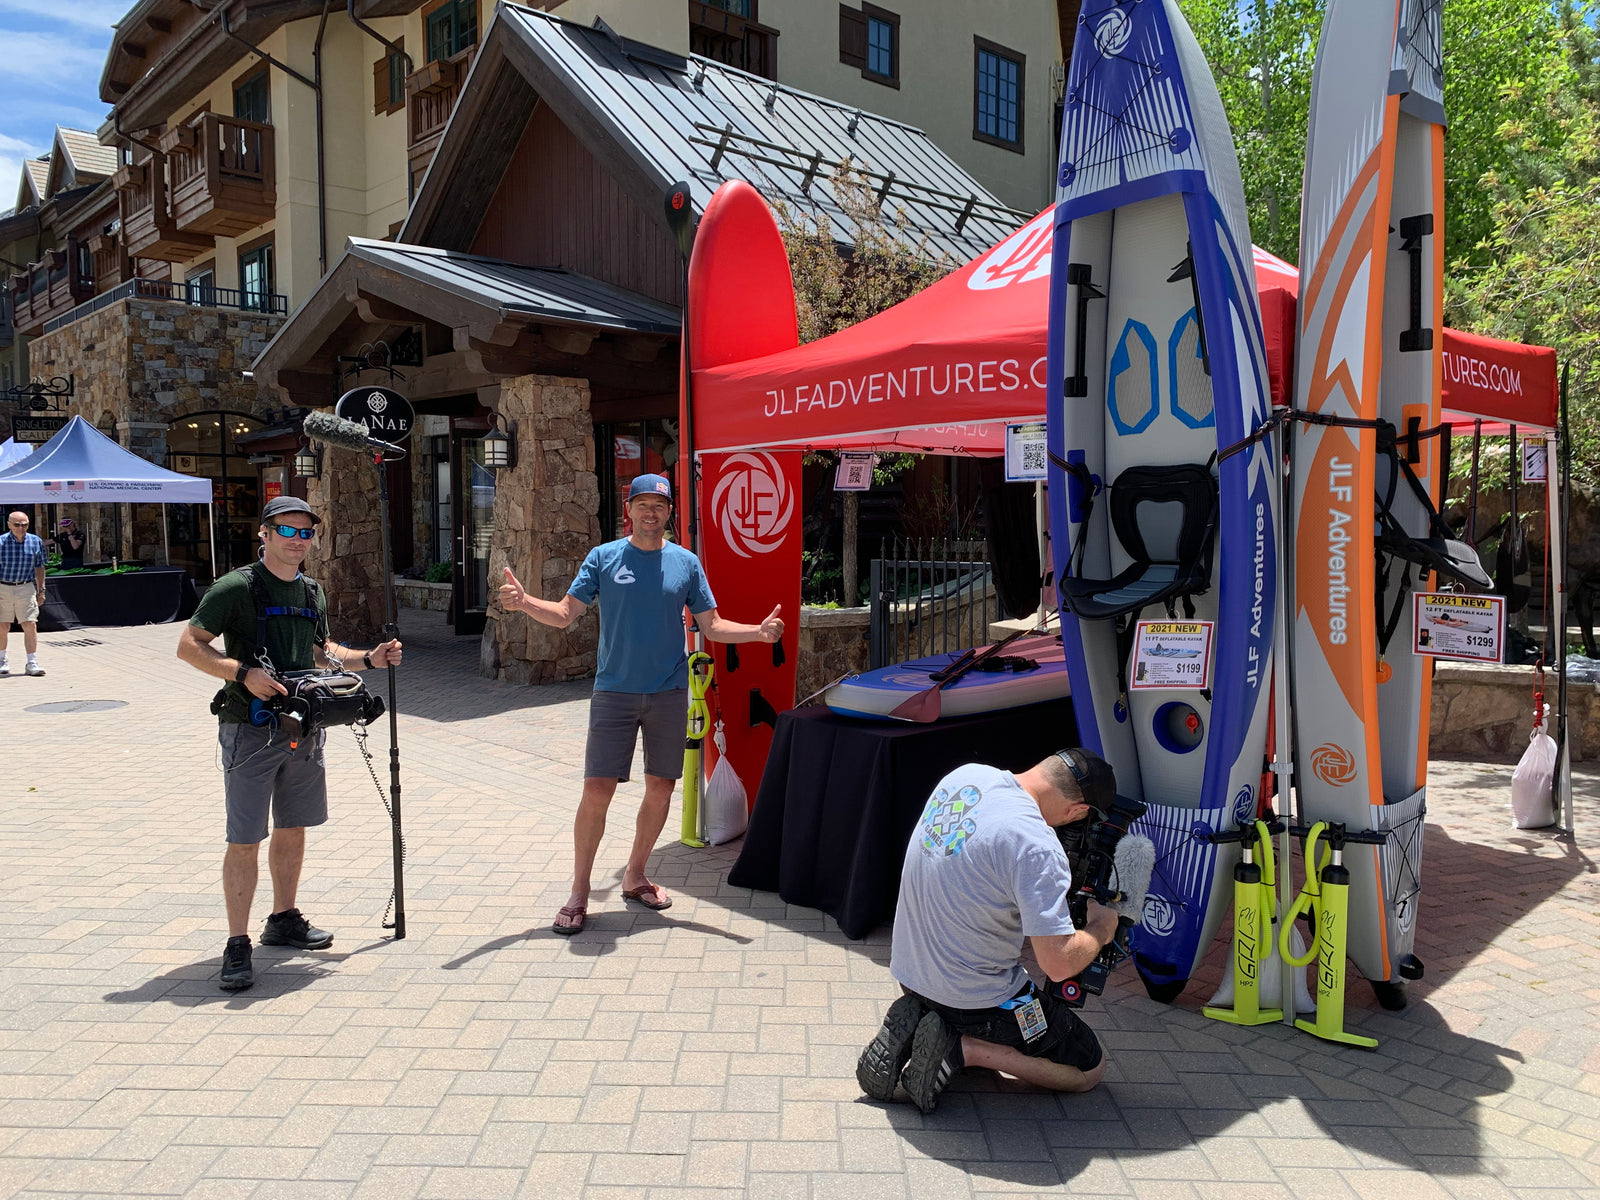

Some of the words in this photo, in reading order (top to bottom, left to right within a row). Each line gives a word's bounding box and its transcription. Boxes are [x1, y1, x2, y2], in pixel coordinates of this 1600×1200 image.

[1329, 455, 1353, 503] JLF
[1250, 502, 1265, 639] Adventures
[1328, 508, 1352, 646] Adventures
[1431, 596, 1457, 606] 2021
[1461, 598, 1487, 608] NEW
[1150, 624, 1172, 633] 2021
[1175, 624, 1198, 633] NEW
[1466, 635, 1494, 648] $1299
[1176, 663, 1201, 674] $1199
[1246, 646, 1260, 689] JLF
[924, 824, 944, 848] GAMES
[1240, 979, 1254, 988] HP2
